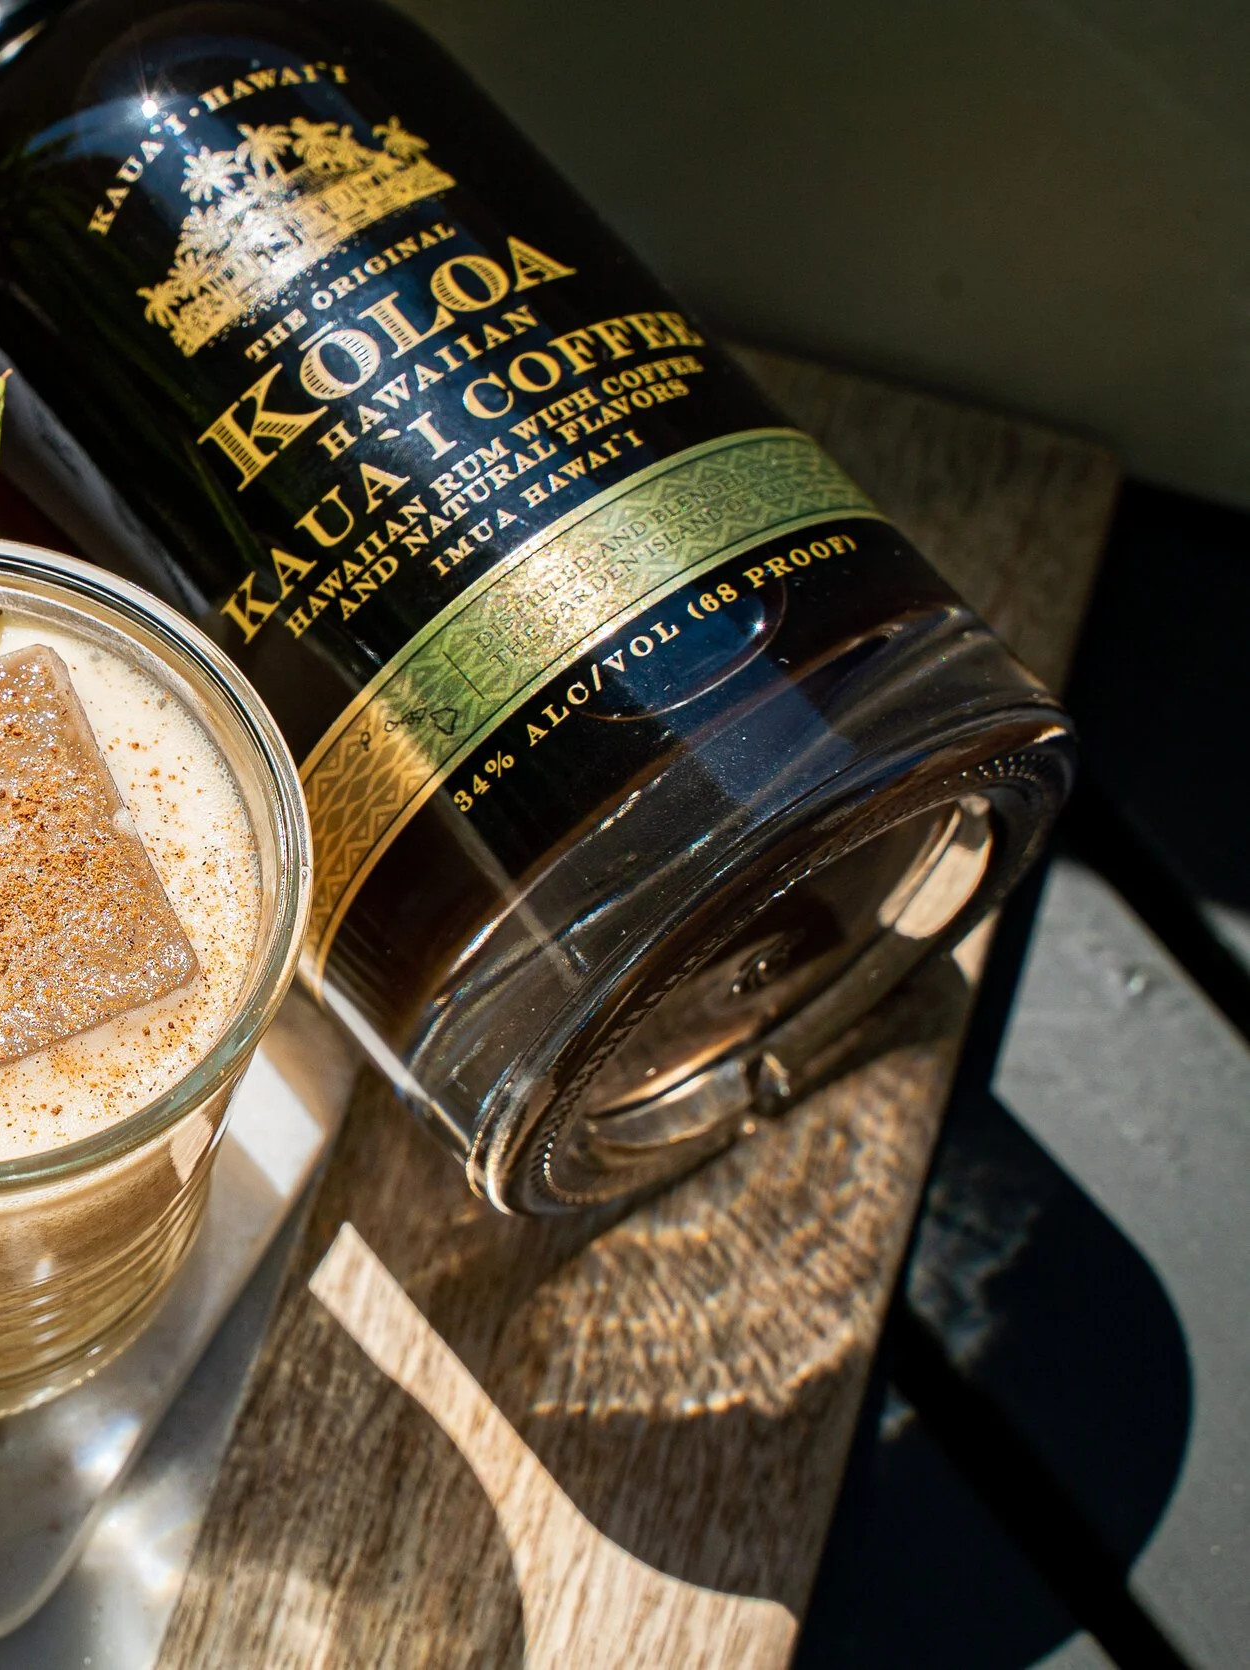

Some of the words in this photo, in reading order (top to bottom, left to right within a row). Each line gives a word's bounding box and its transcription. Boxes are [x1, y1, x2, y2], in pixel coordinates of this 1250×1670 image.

[244, 308, 309, 363] THE
[311, 220, 457, 311] ORIGINAL
[461, 310, 706, 420] COFFEE
[316, 305, 541, 461] HAWAIIAN
[284, 495, 431, 640] HAWAIIAN
[429, 436, 513, 502] RUM
[508, 385, 602, 443] WITH
[601, 354, 705, 397] COFFEE
[339, 554, 400, 622] AND
[400, 438, 559, 557] NATURAL
[558, 377, 691, 447] FLAVORS
[430, 508, 518, 578] IMUA
[472, 554, 593, 652] DISTILLED
[597, 517, 648, 560] AND
[649, 471, 747, 525] BLENDED
[489, 628, 541, 668] THE
[542, 550, 640, 628] GARDEN
[646, 506, 724, 558] ISLAND
[454, 750, 516, 812] 34%
[525, 620, 681, 747] ALC/VOL
[687, 582, 739, 621] (68
[742, 533, 858, 589] PROOF)
